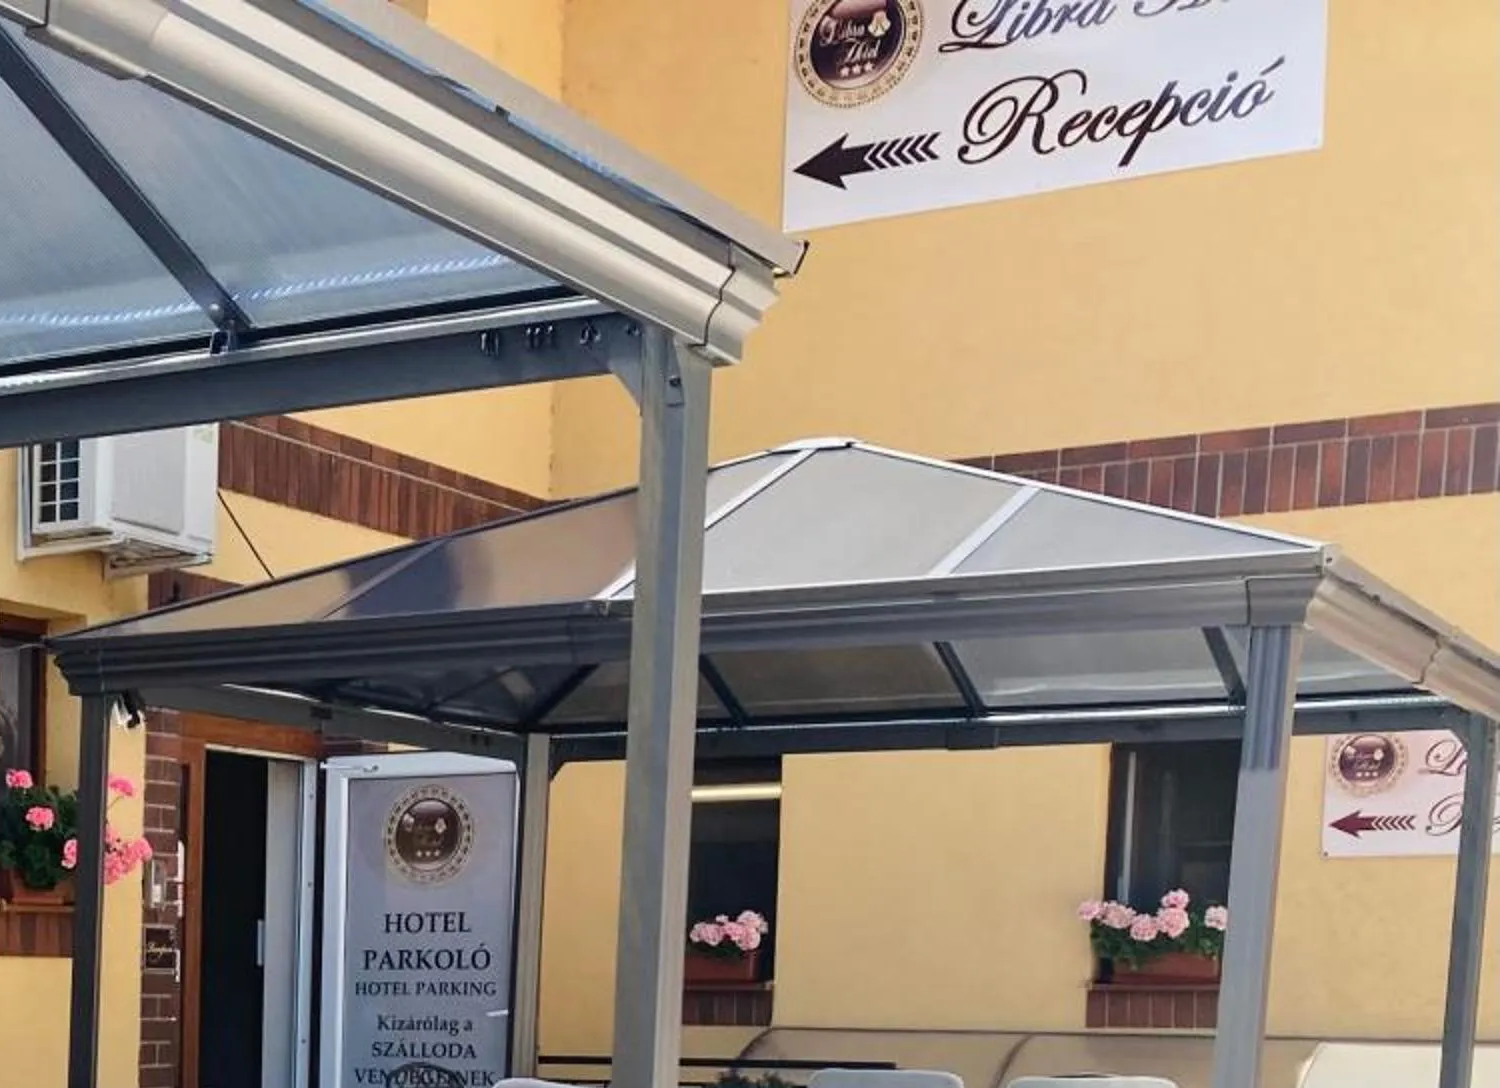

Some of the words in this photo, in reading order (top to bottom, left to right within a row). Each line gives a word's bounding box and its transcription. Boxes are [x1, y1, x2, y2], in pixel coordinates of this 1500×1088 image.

[938, 0, 1117, 53] Libra
[957, 56, 1286, 167] Recepció
[384, 911, 472, 934] HOTEL
[363, 942, 491, 971] PARKOLÓ
[355, 980, 411, 997] HOTEL
[415, 980, 497, 997] PARKING
[377, 1013, 459, 1036] Kizárólag
[464, 1019, 474, 1032] a
[371, 1040, 477, 1060] SZÁLLODA
